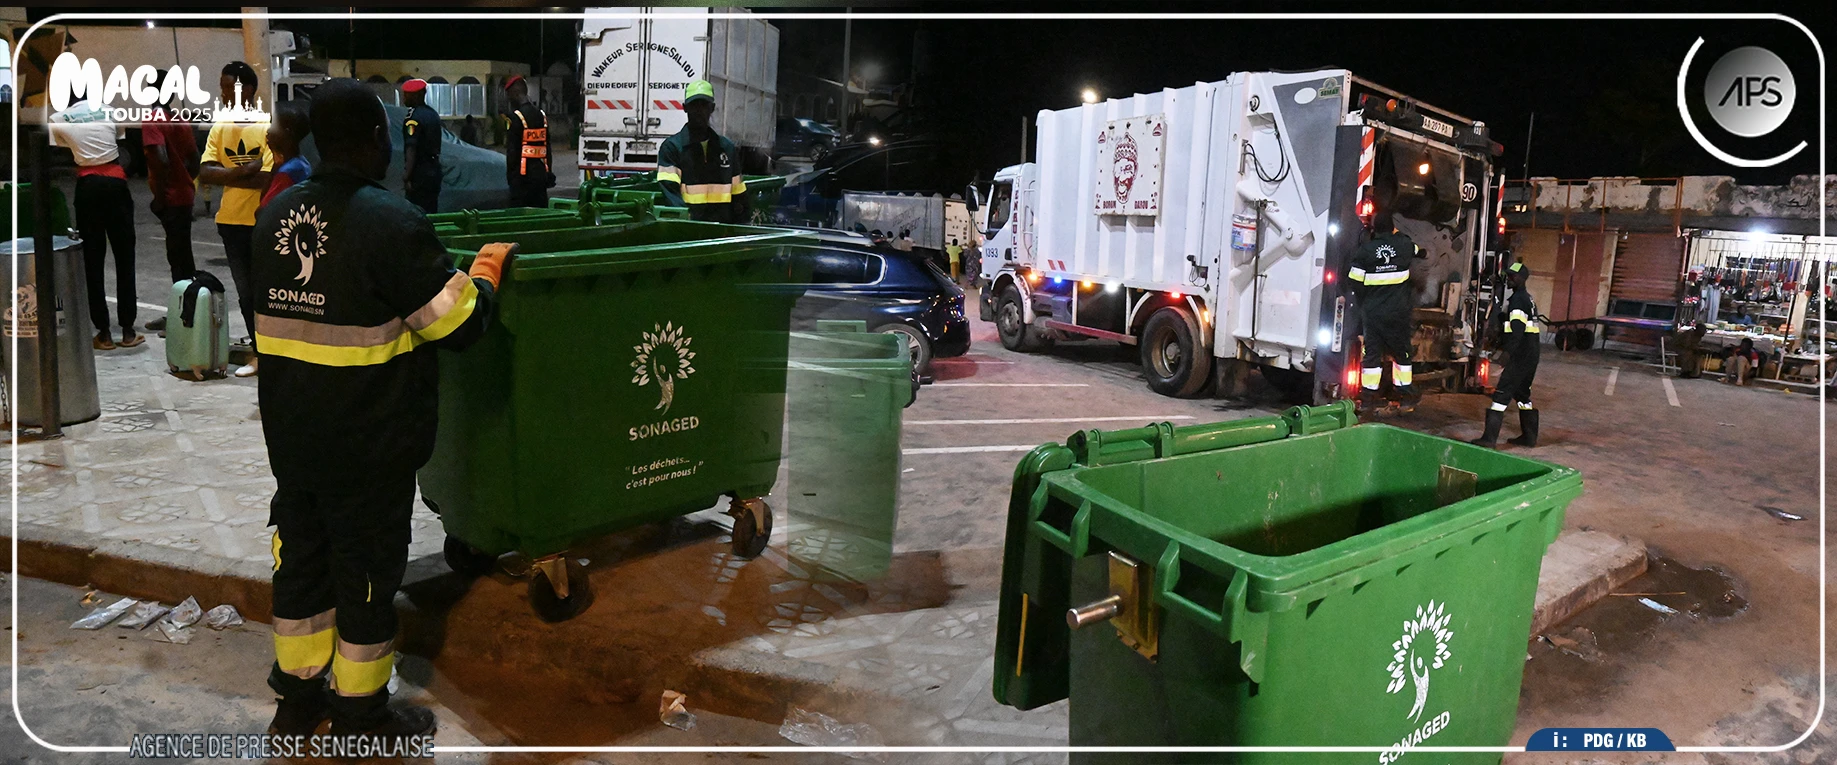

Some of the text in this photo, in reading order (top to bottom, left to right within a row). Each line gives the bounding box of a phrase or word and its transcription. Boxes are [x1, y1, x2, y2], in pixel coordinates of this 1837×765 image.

[591, 48, 624, 78] WAKEUR
[649, 82, 680, 90] SERIGNE
[527, 131, 545, 140] POLE
[1462, 185, 1475, 200] 90
[629, 416, 700, 441] SONAGED
[626, 477, 648, 489] c'est
[648, 473, 670, 486] pour
[671, 468, 692, 479] nous
[1379, 710, 1451, 765] SONAGED
